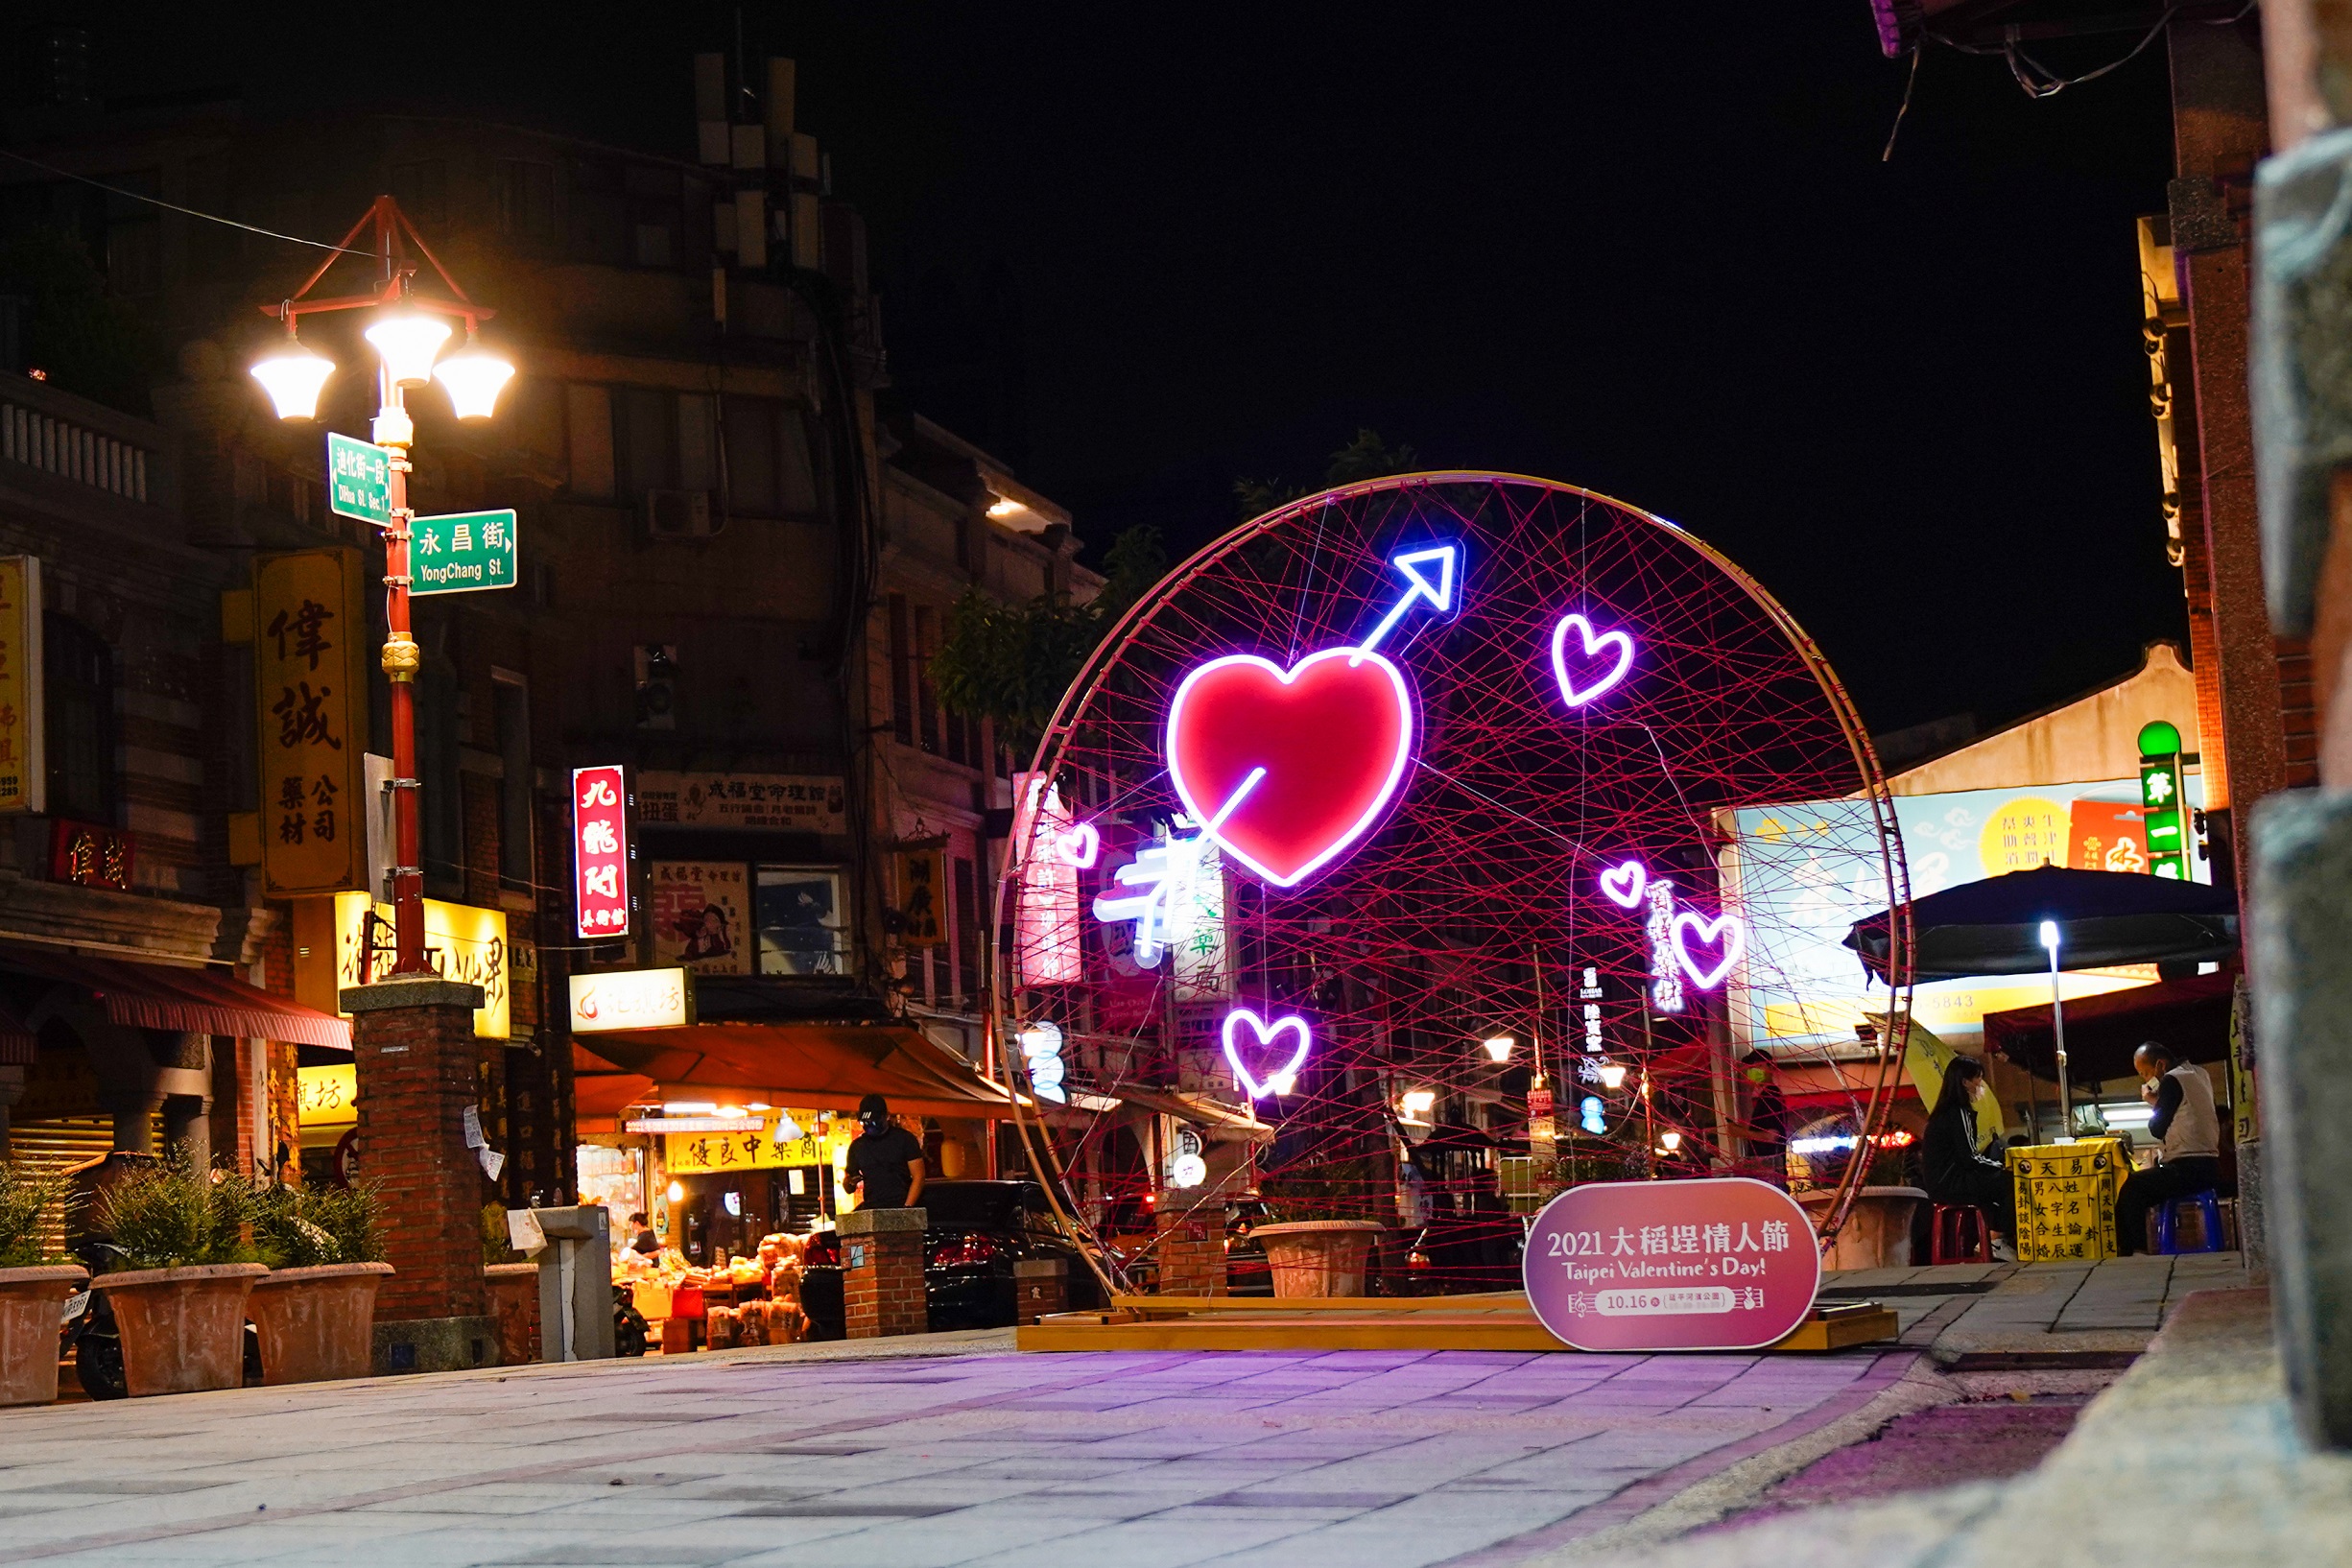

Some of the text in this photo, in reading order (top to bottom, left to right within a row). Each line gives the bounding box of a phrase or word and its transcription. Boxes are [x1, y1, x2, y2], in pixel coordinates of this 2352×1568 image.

[336, 446, 386, 486] 迪化街一段
[418, 521, 506, 556] 永昌街
[420, 558, 505, 584] YongChang St.
[267, 598, 342, 751] 偉誠
[0, 775, 18, 786] 959
[0, 786, 18, 796] 289
[310, 772, 339, 843] 公司
[2033, 1180, 2050, 1259] 男女合婚
[2048, 1182, 2067, 1259] 八字生辰
[2064, 1180, 2084, 1258] 姓名論運
[1561, 1256, 1766, 1286] Taipei Valentine's Day!
[1606, 1295, 1648, 1310] 10.16
